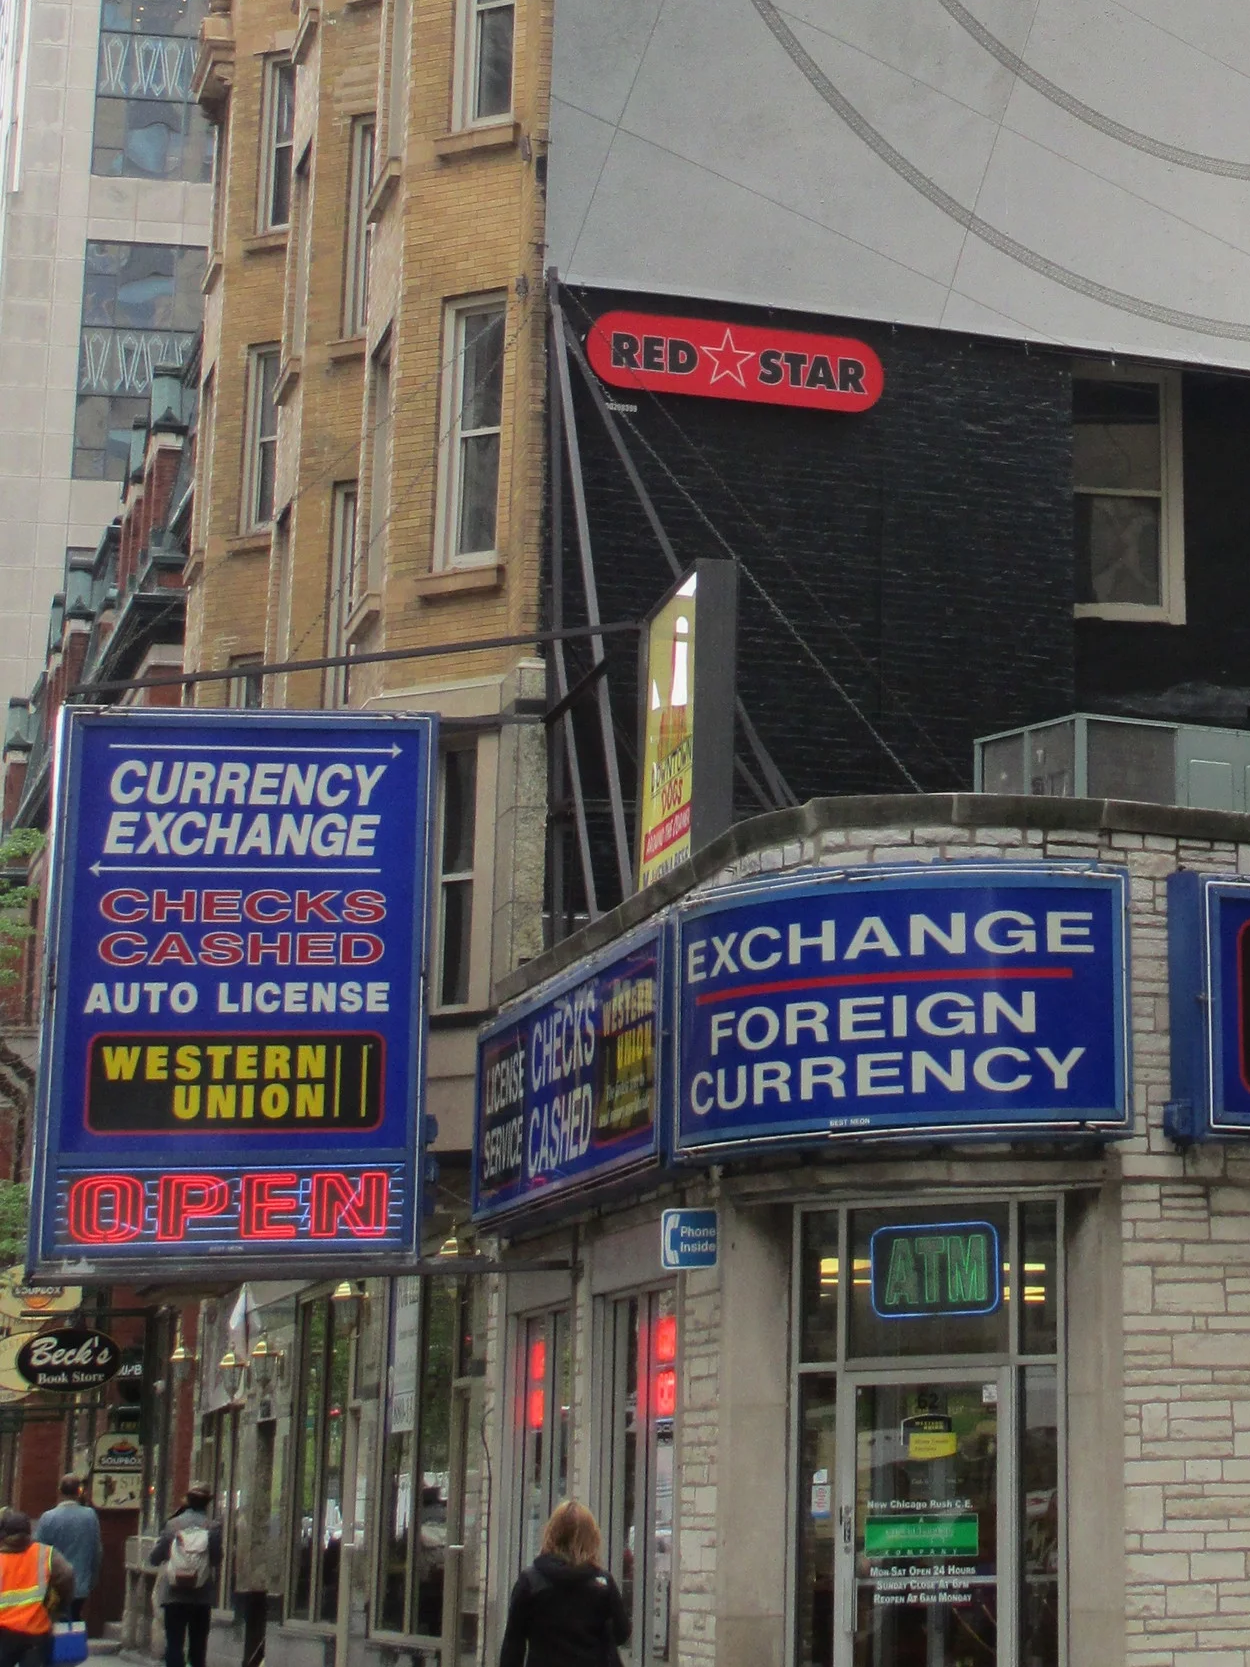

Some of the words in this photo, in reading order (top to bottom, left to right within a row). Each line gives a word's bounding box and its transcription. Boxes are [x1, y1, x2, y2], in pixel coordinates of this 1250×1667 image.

[611, 331, 698, 375] RED
[758, 349, 868, 395] STAR
[110, 760, 387, 805] CURRENCY
[661, 777, 684, 814] DOGS
[103, 814, 381, 856] EXCHANGE
[100, 888, 387, 924] CHECKS
[98, 931, 385, 967] CASHED
[687, 911, 1095, 984] EXCHANGE
[84, 982, 198, 1013] AUTO
[218, 982, 390, 1013] LICENSE
[602, 979, 653, 1036] WESTERN
[531, 990, 596, 1092] CHECKS
[617, 1019, 653, 1070] UNION
[711, 991, 1037, 1056] FOREIGN
[102, 1045, 327, 1080] WESTERN
[485, 1049, 526, 1116] LICENSE
[691, 1047, 1086, 1115] CURRENCY
[172, 1084, 325, 1120] UNION
[484, 1116, 524, 1179] SERVICE
[528, 1083, 593, 1178] CASHED
[67, 1171, 390, 1244] OPEN
[680, 1241, 716, 1252] Inside
[681, 1226, 716, 1237] Phone
[885, 1235, 987, 1305] ATM
[31, 1336, 112, 1365] Beck's
[38, 1373, 68, 1384] Book
[72, 1371, 104, 1383] Store
[890, 1500, 927, 1510] Chicago
[930, 1500, 952, 1508] Rush
[933, 1566, 945, 1574] 24
